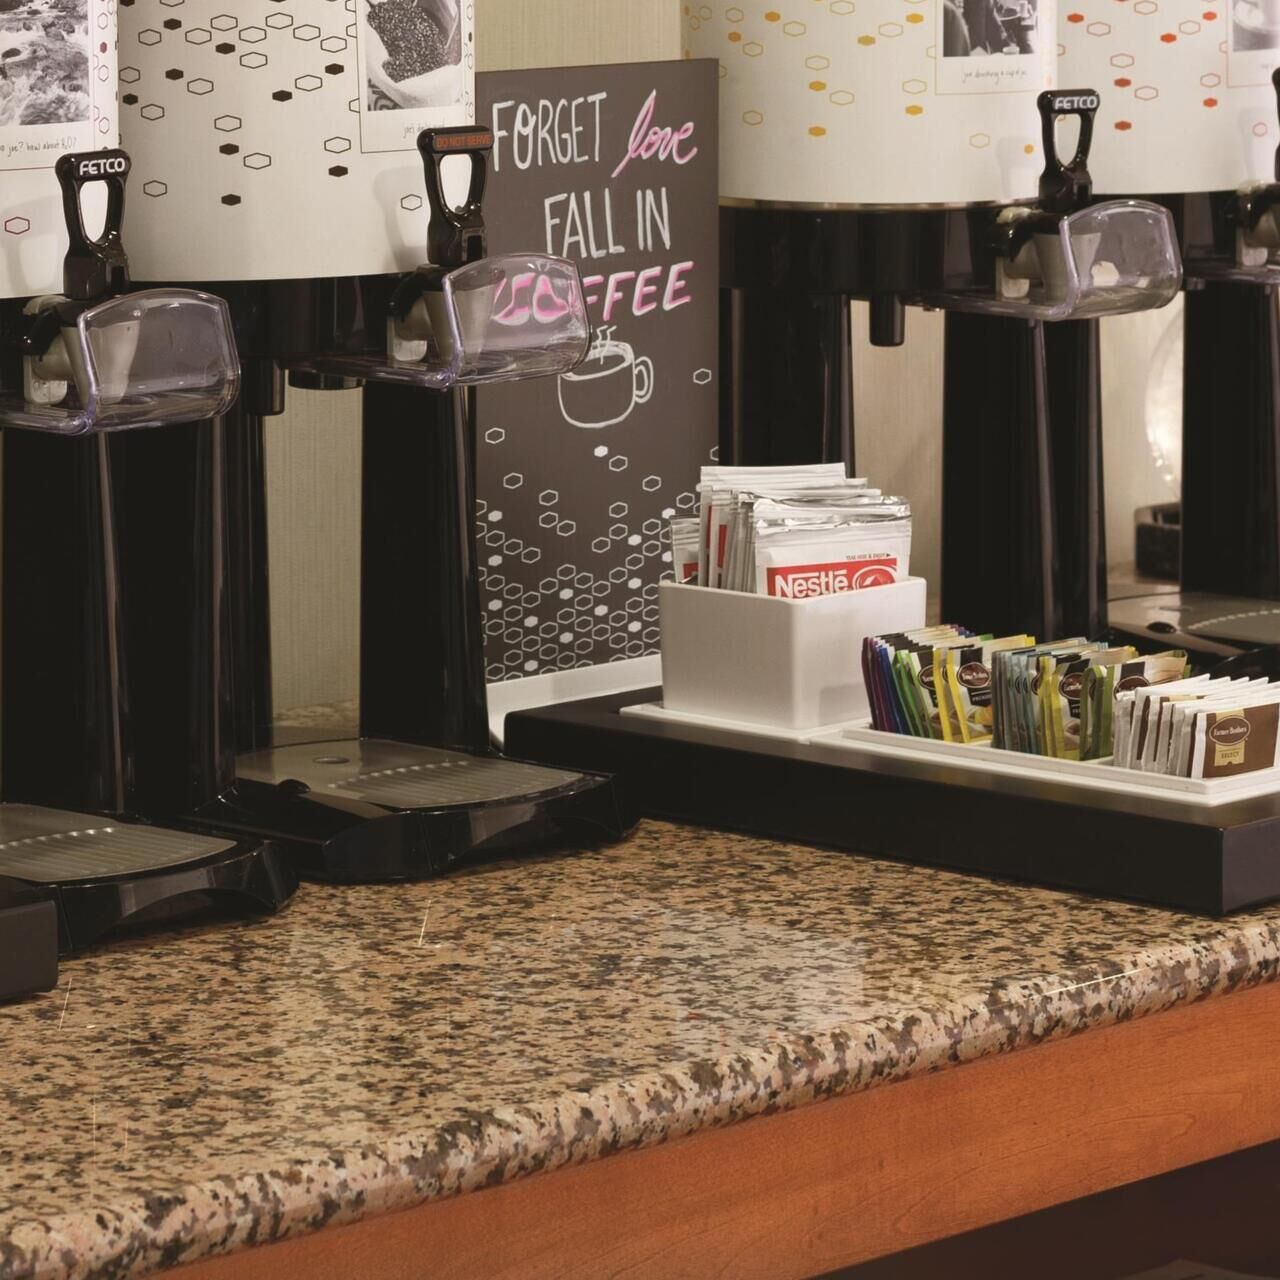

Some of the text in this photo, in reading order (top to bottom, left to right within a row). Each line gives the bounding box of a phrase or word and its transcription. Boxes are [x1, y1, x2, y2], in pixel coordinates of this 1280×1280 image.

[1054, 95, 1098, 110] FETCO
[492, 88, 699, 179] FORGET love
[79, 157, 127, 176] FETCO
[544, 186, 671, 259] FALL IN
